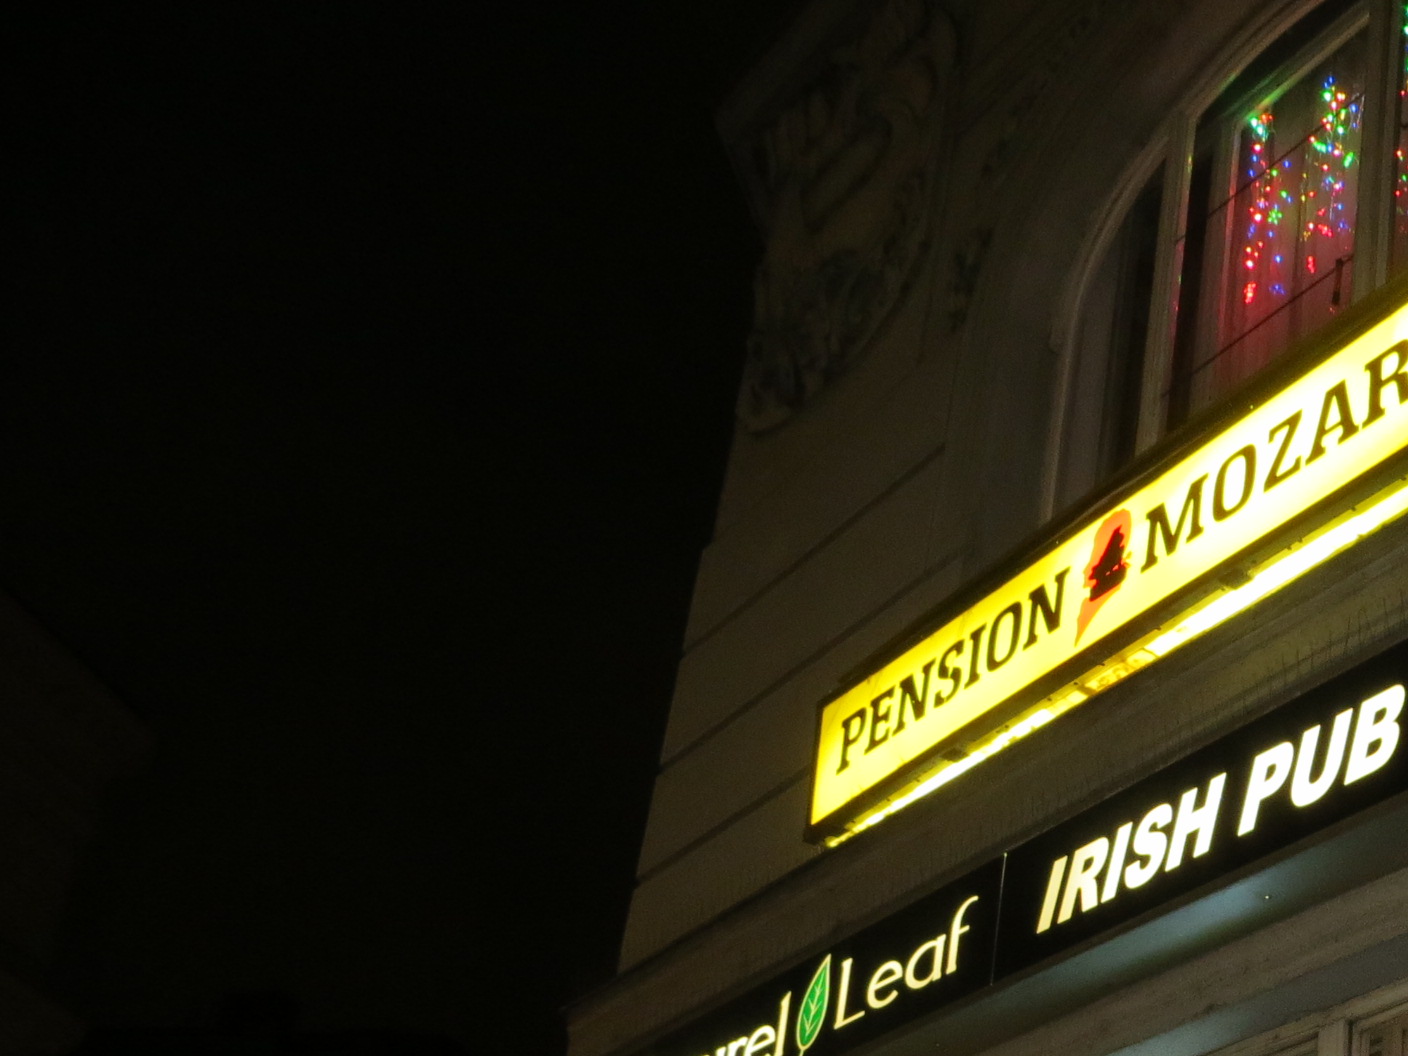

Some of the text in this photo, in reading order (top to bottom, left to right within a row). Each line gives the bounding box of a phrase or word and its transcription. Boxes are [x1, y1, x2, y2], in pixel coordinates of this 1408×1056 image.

[834, 568, 1071, 775] PENSION
[1035, 771, 1227, 935] IRISH
[1237, 683, 1407, 838] PUB
[832, 894, 980, 1031] Leaf
